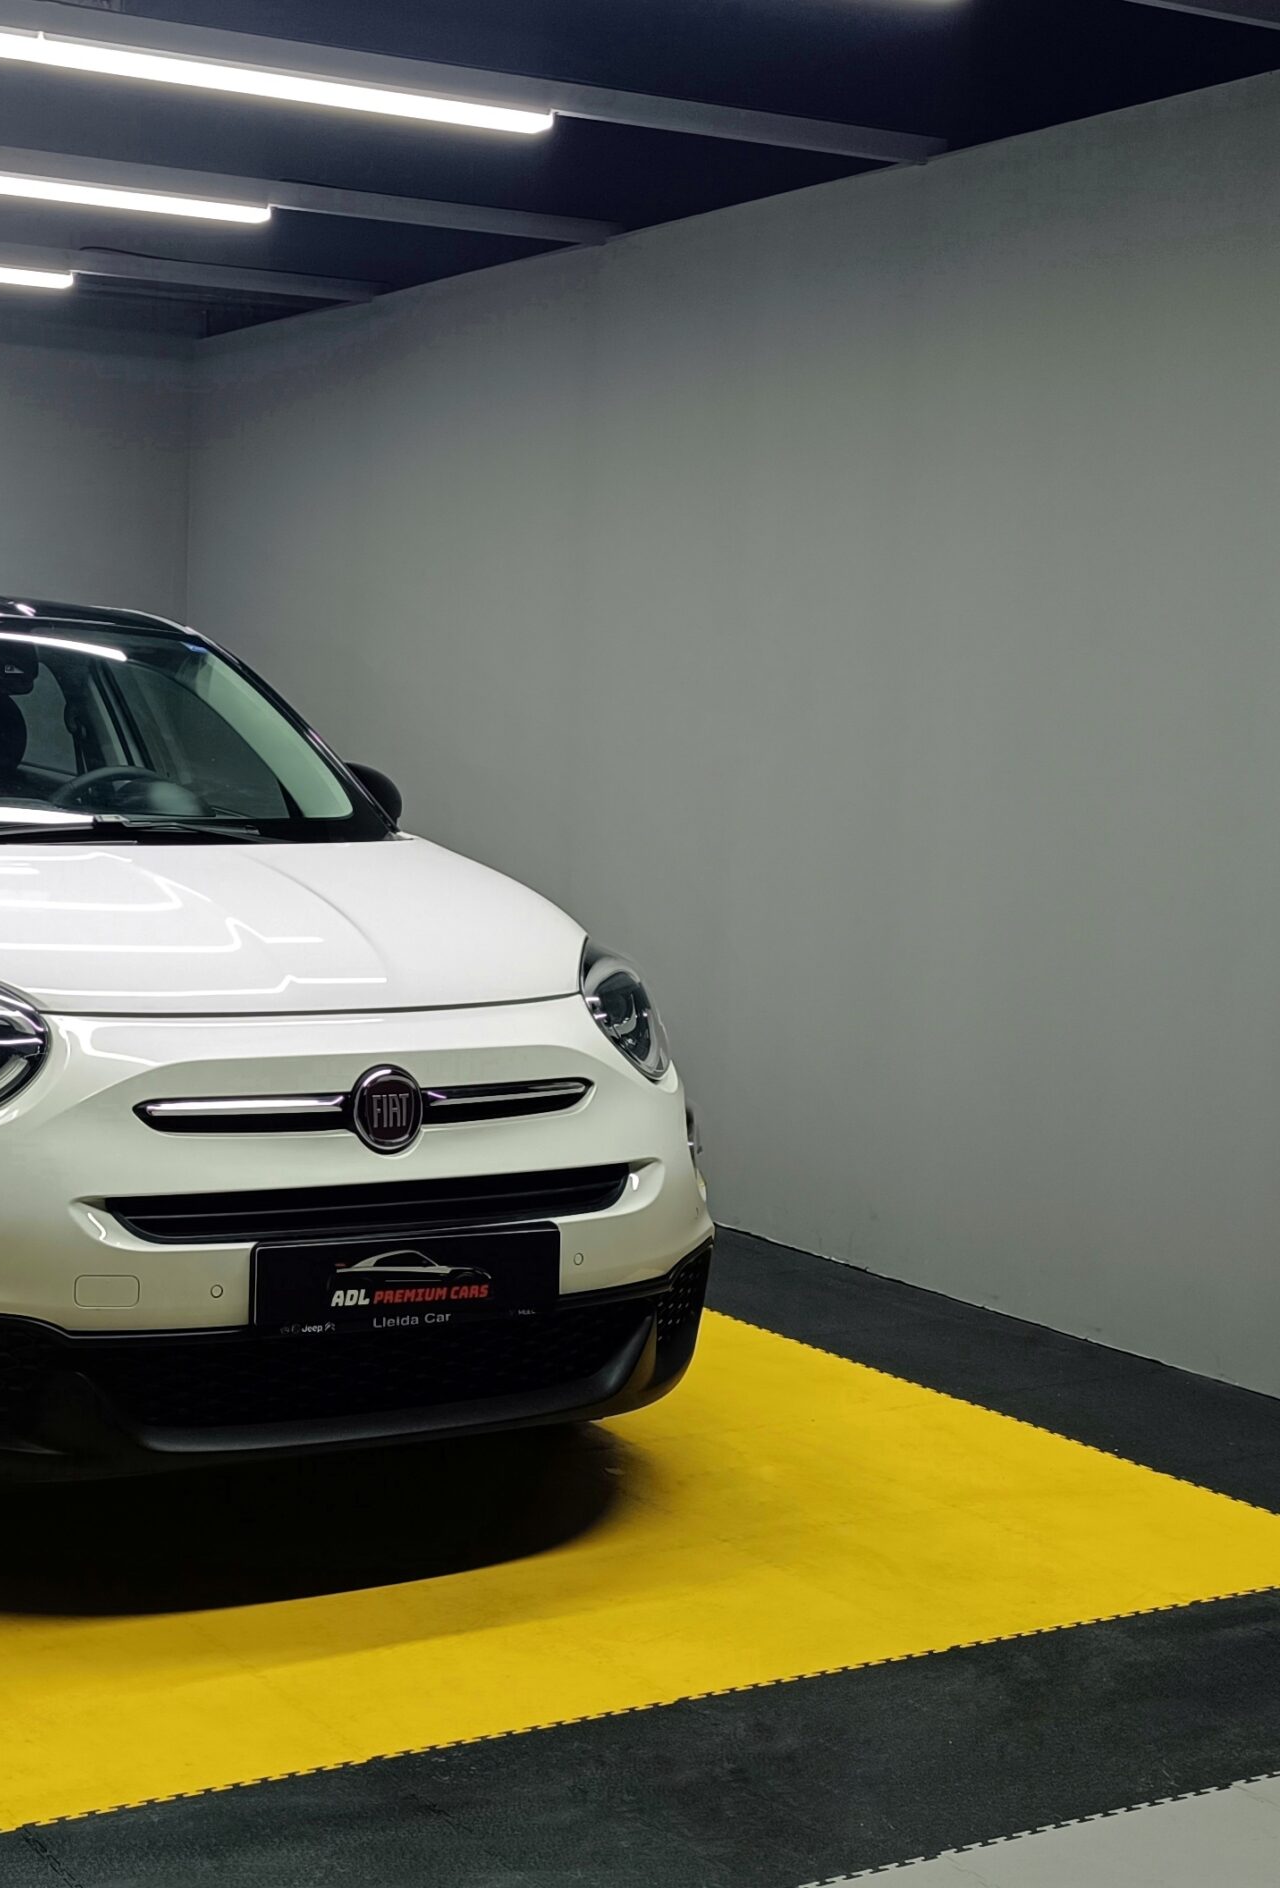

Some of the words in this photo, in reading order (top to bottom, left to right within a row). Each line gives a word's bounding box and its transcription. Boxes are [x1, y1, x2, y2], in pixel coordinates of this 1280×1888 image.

[371, 1093, 410, 1129] FIAT
[330, 1289, 370, 1307] ADL
[373, 1287, 448, 1305] PREMIUM
[450, 1284, 489, 1299] CARS
[424, 1312, 451, 1325] Car
[301, 1324, 324, 1333] Jeep
